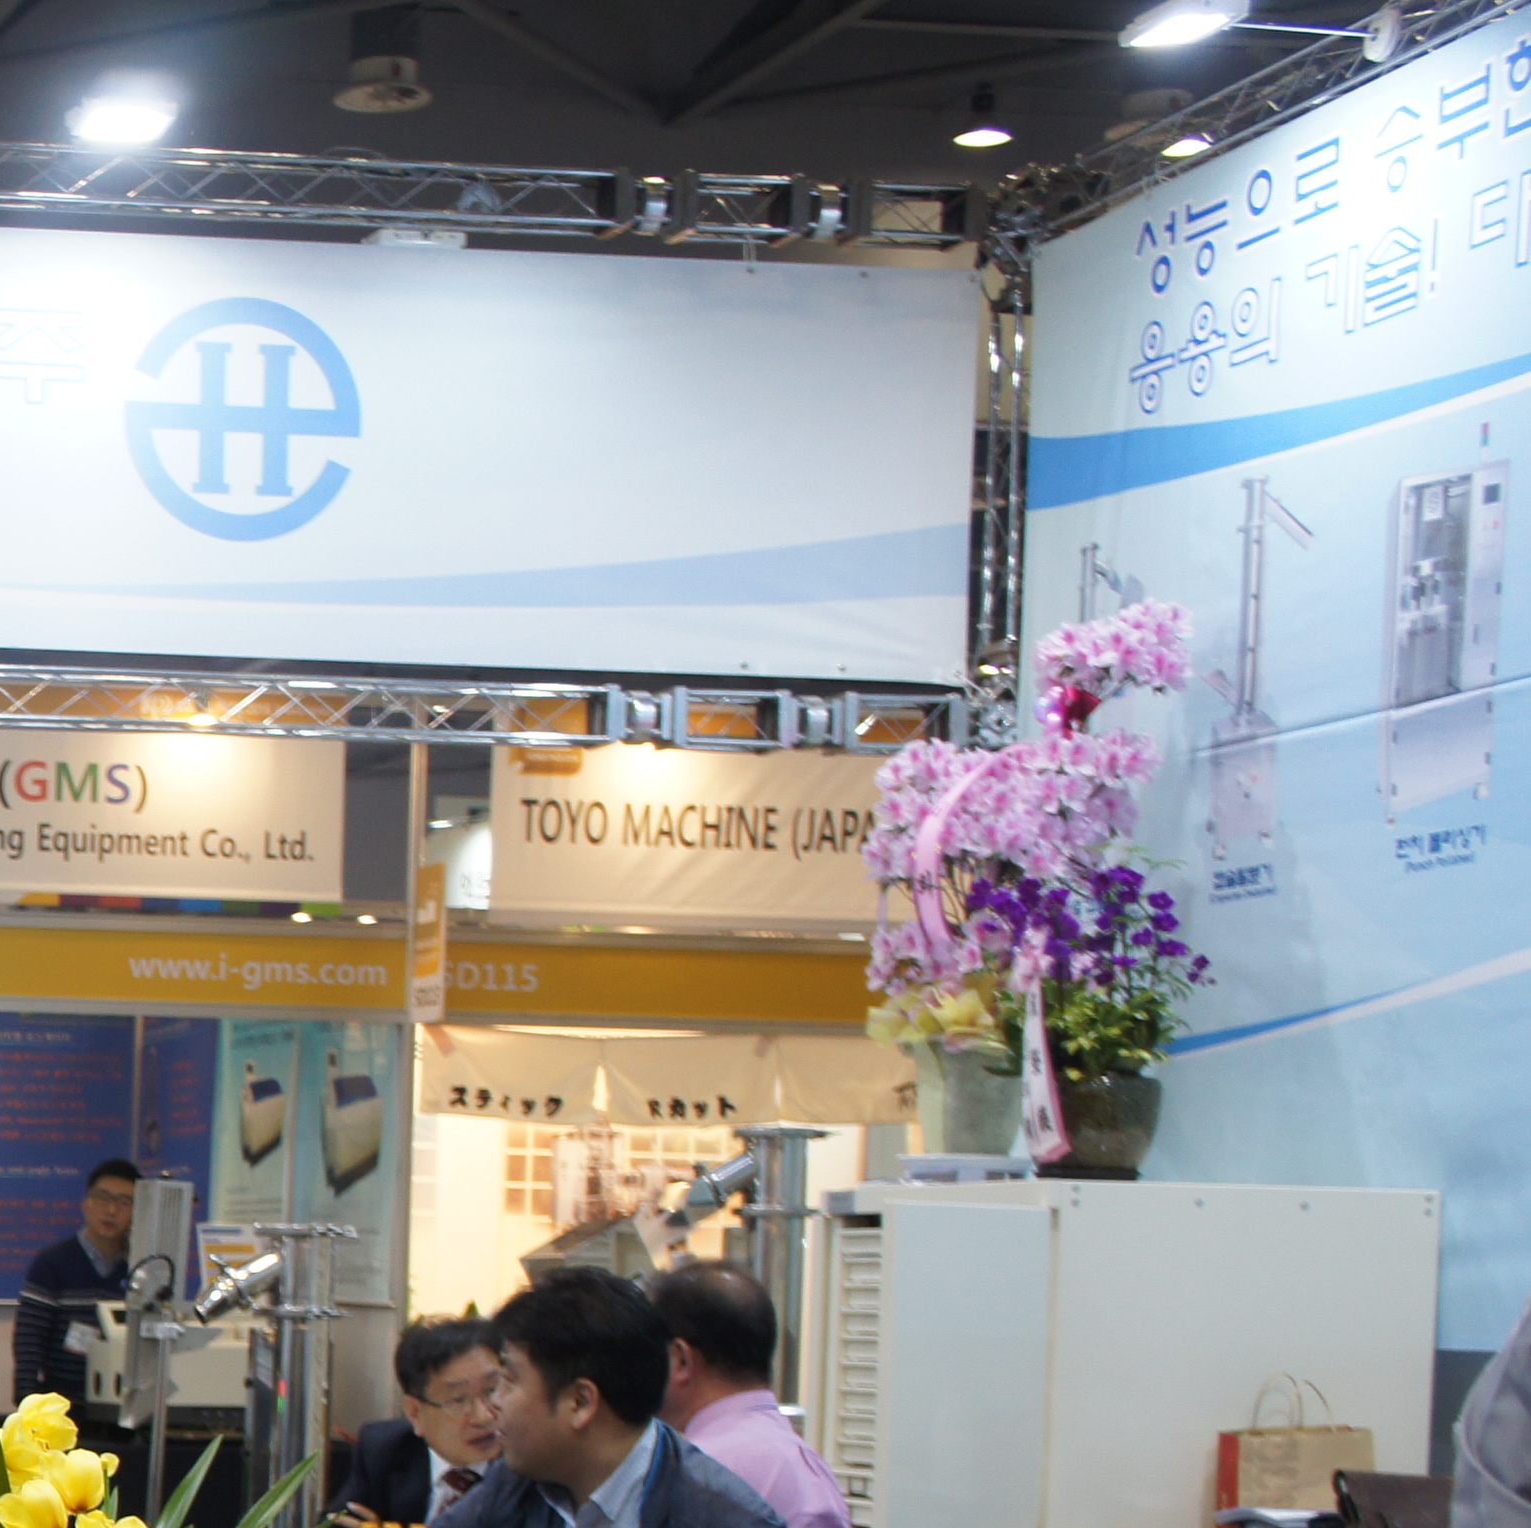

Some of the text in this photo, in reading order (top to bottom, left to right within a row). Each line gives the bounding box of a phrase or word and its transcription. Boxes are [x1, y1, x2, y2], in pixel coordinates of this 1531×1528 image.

[1135, 134, 1341, 294] 성능으로
[1130, 277, 1283, 414] 응용의
[37, 822, 190, 861] Equipment
[200, 829, 252, 864] Co.,
[265, 831, 315, 863] Ltd.
[520, 798, 877, 862] TOYO MACHINE (JAPA
[128, 953, 388, 991] www.i-gms.com
[449, 1085, 565, 1118] スティック
